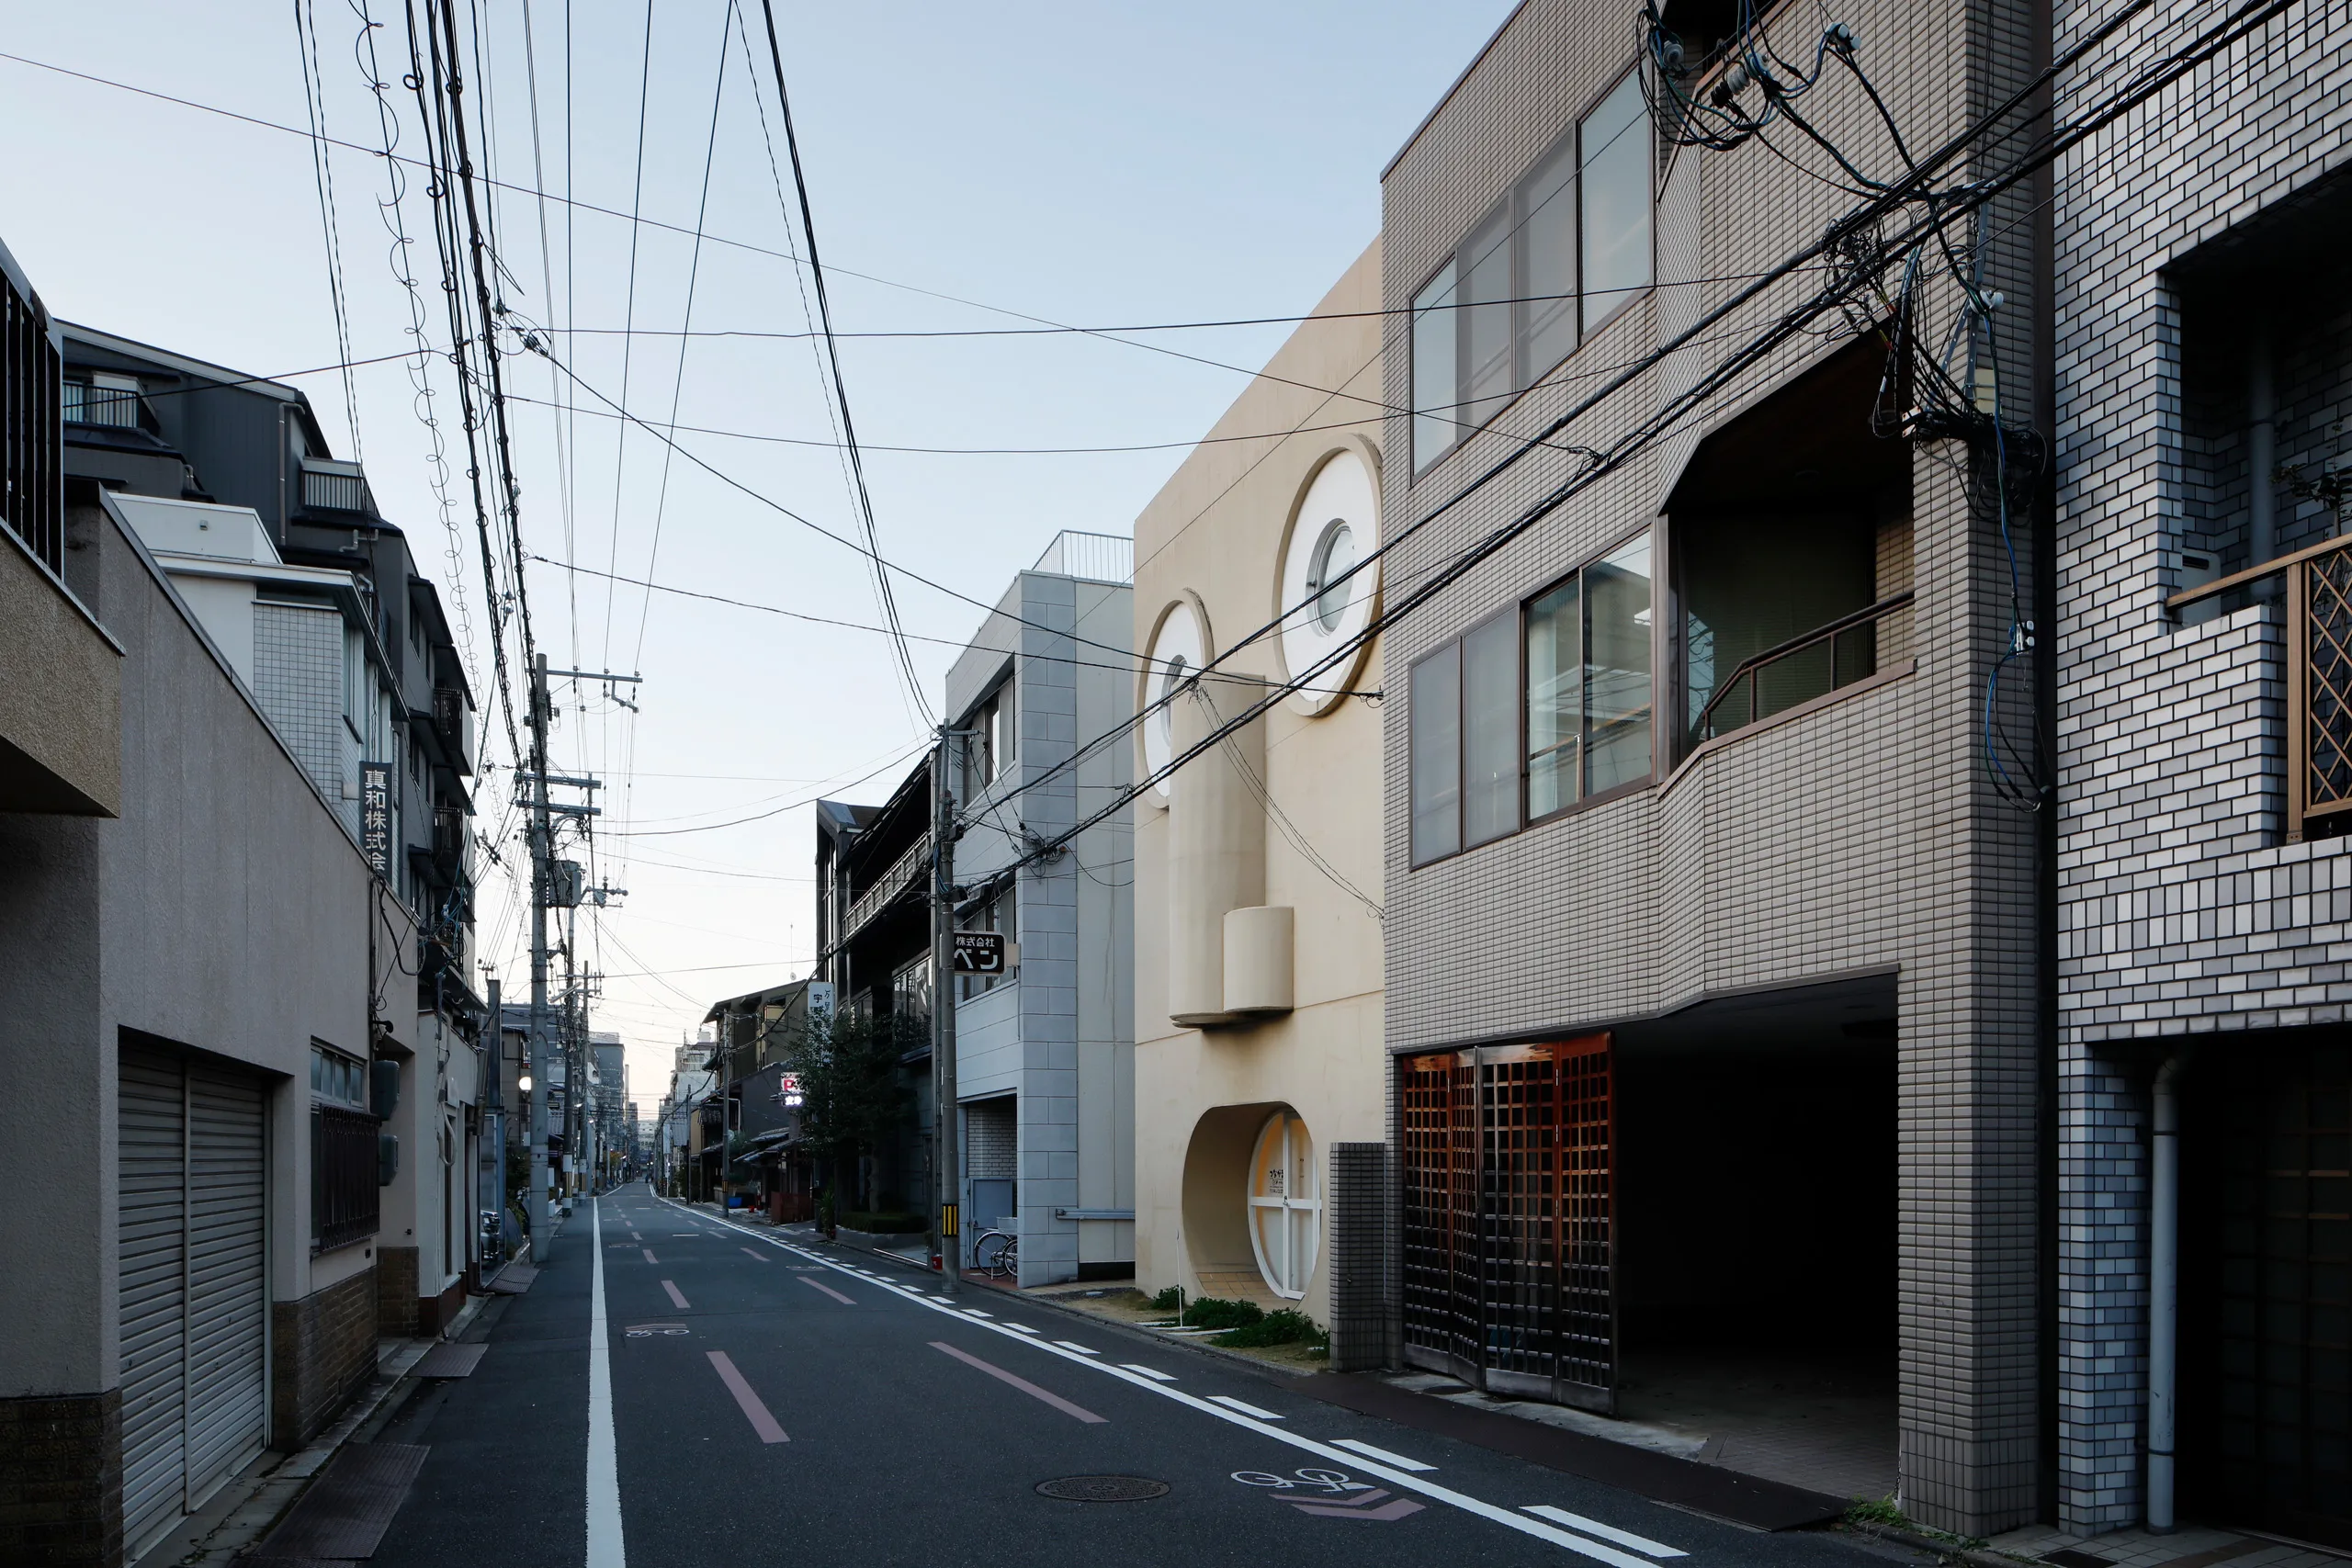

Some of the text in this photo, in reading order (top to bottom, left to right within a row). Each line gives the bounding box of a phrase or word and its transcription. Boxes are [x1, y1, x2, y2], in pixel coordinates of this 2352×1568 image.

[956, 936, 995, 947] 株式会社
[784, 1079, 795, 1092] P
